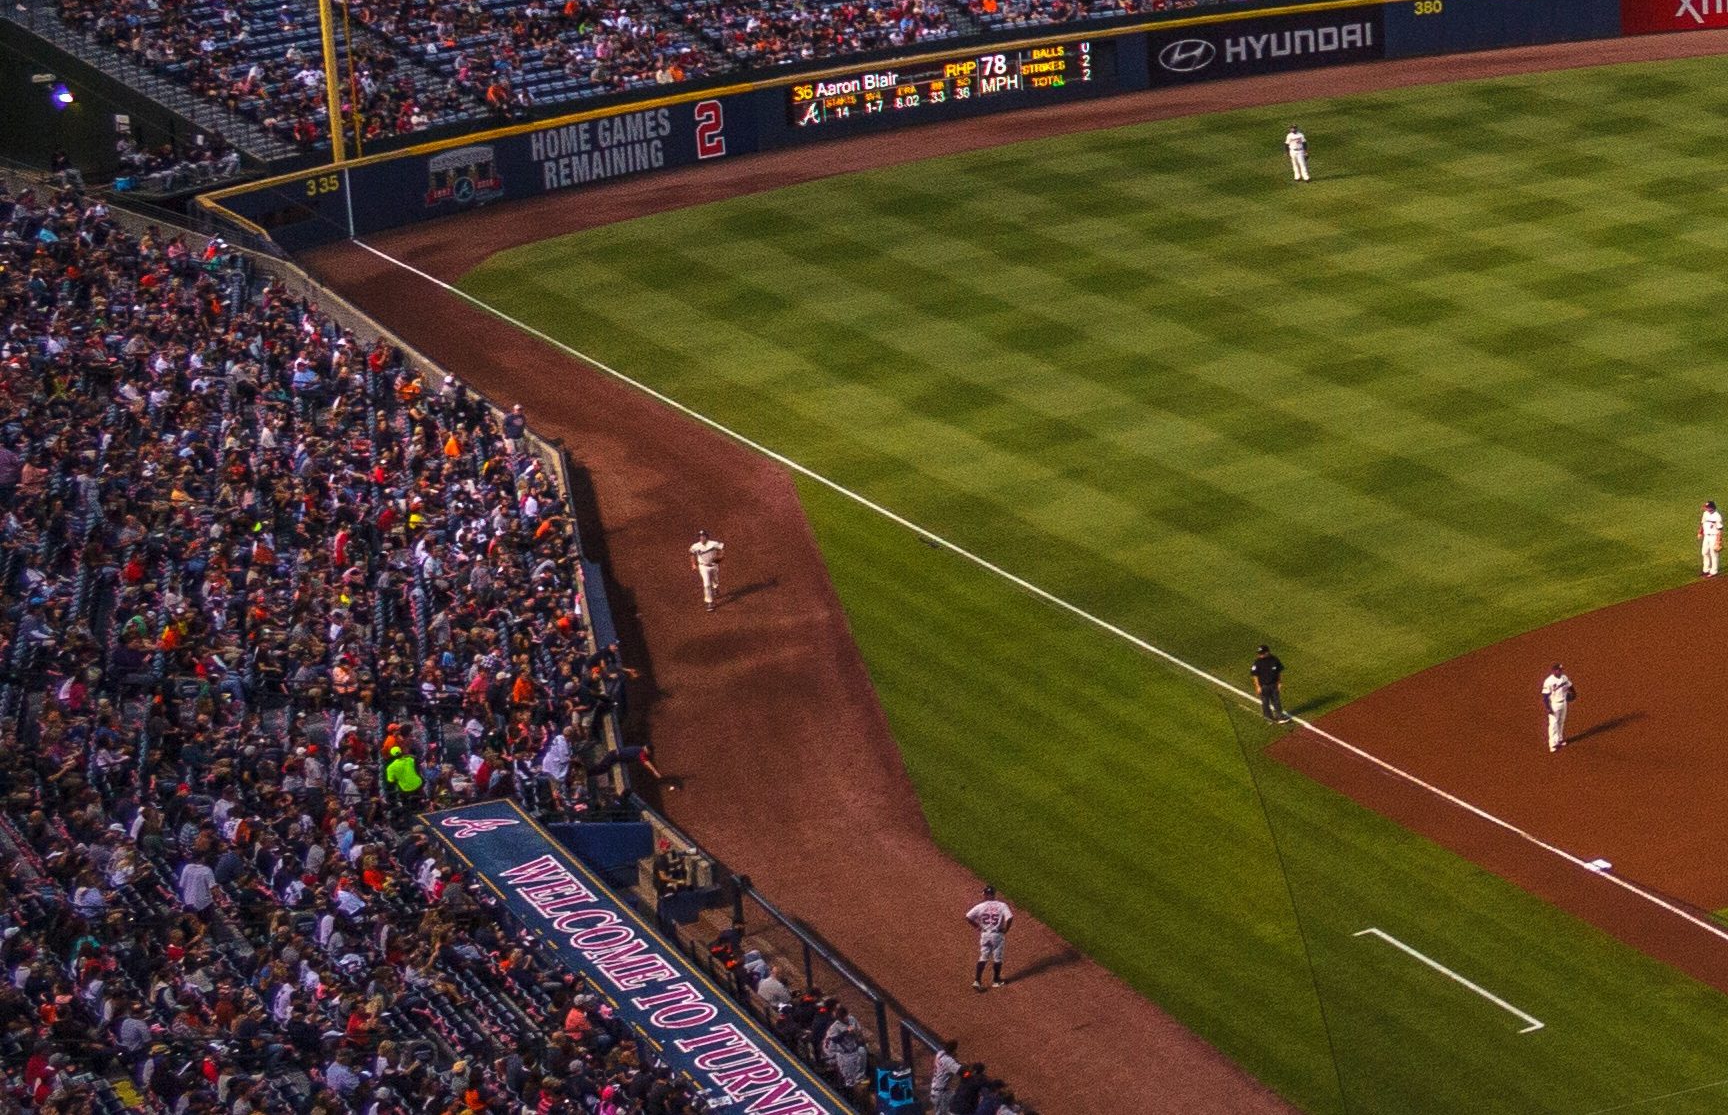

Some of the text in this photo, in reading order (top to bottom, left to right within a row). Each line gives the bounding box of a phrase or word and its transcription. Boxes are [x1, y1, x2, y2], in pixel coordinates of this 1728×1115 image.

[1414, 0, 1443, 17] 380
[1224, 21, 1372, 64] HYUNDAI
[794, 85, 814, 102] 36
[816, 80, 860, 97] Aaron
[863, 72, 898, 90] Blair
[944, 62, 976, 78] RHP
[981, 55, 1006, 76] 78
[981, 75, 1018, 94] MPH
[531, 109, 671, 161] HOME GAMES
[695, 100, 726, 159] 2
[543, 141, 664, 189] REMAINING
[306, 177, 339, 197] 335
[499, 855, 681, 992] WELCOME
[632, 982, 718, 1030] TO
